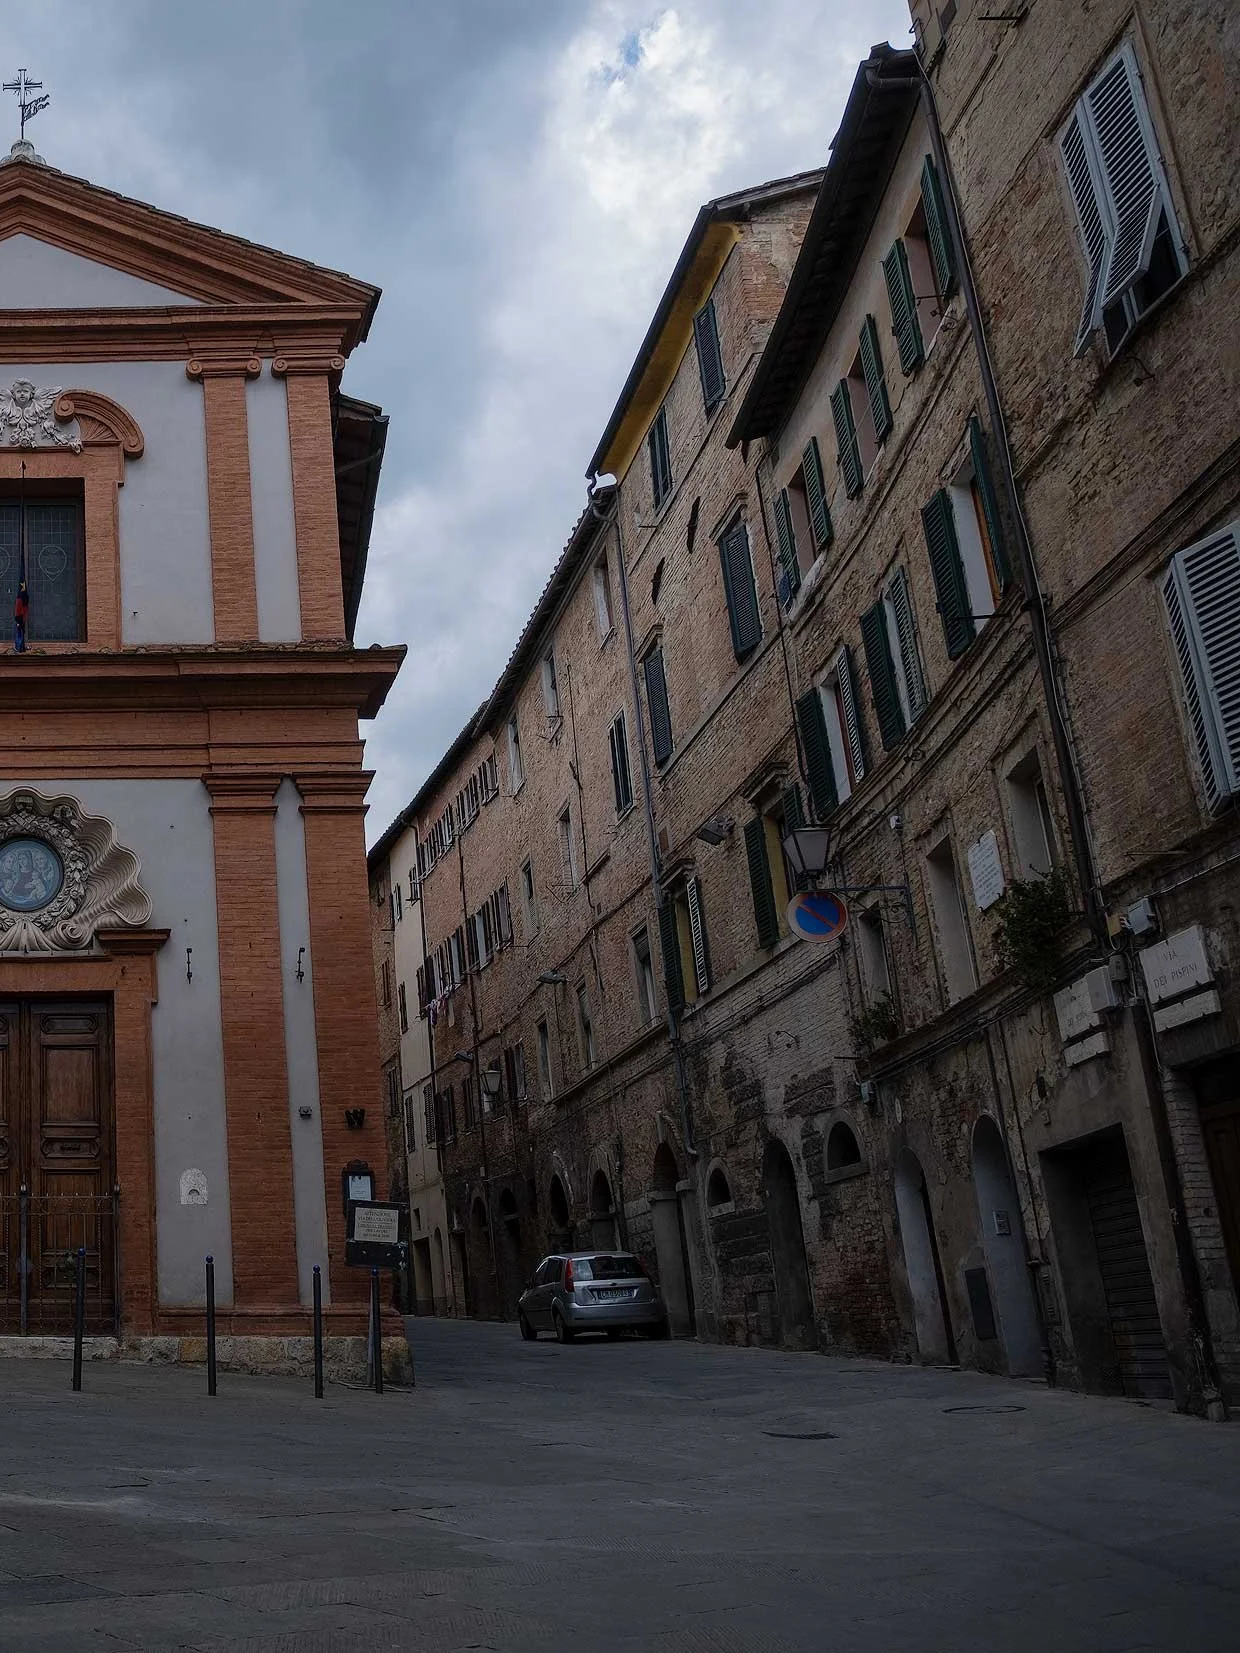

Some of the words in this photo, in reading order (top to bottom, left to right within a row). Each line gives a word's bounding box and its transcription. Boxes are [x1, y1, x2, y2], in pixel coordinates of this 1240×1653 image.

[1160, 949, 1177, 961] VIA
[1153, 975, 1168, 990] DEI
[1171, 961, 1198, 983] PISPINI
